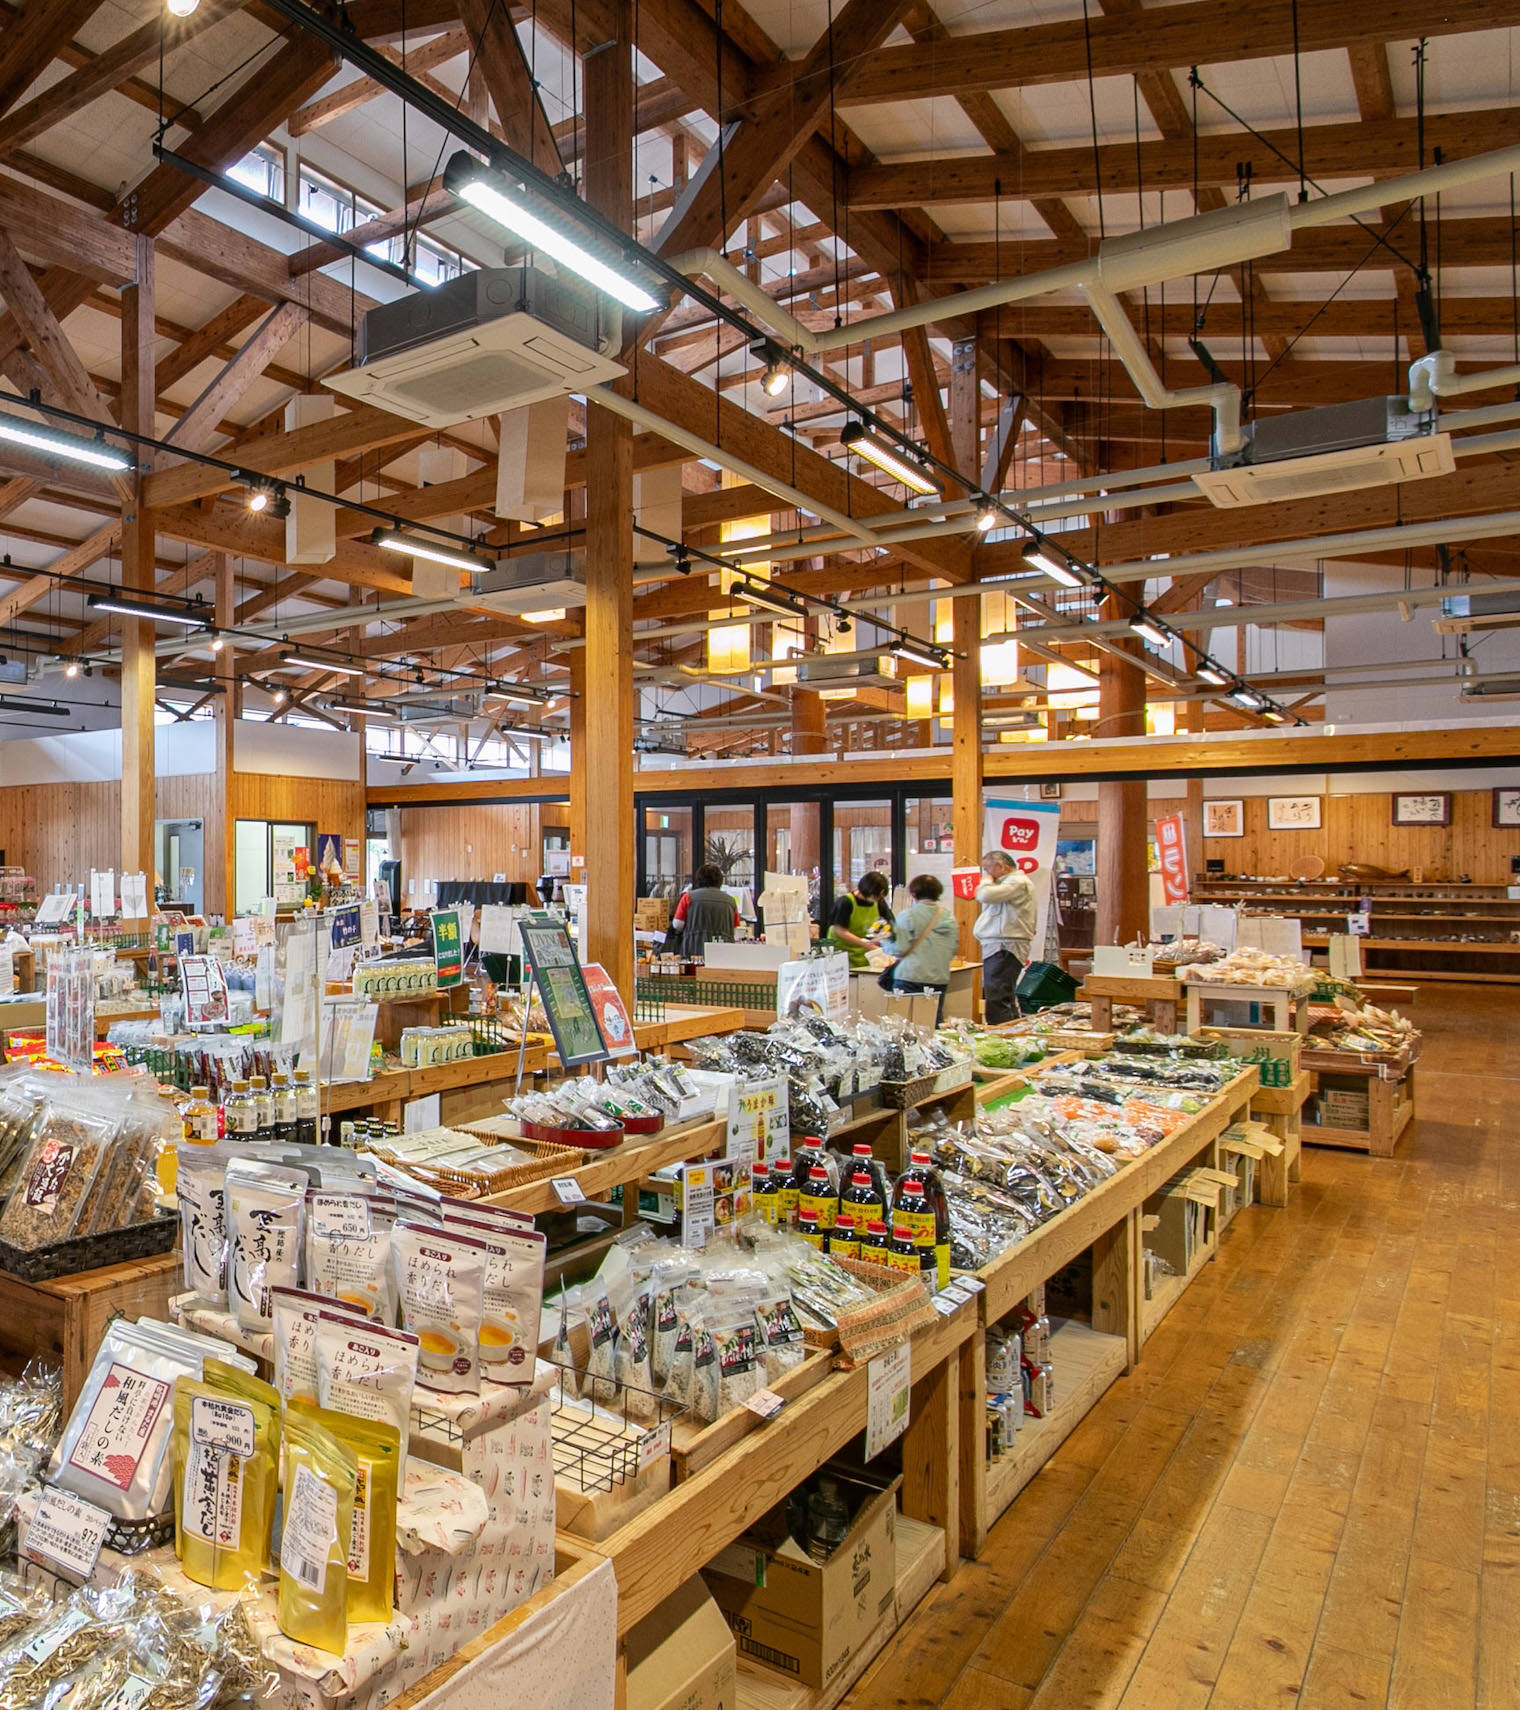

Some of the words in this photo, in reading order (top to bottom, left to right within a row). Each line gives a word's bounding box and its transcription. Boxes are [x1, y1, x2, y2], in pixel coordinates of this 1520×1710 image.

[1009, 825, 1034, 838] Pay
[438, 922, 458, 941] 半額
[342, 1223, 358, 1234] 650
[408, 1256, 457, 1279] ほめられ
[406, 1272, 456, 1296] 香りだし
[350, 1342, 377, 1356] あご入り
[335, 1350, 385, 1375] ほめられ
[331, 1366, 386, 1391] 香りだし
[201, 1401, 246, 1417] 本枯れ黄金だし
[90, 1376, 137, 1467] 和風だしの素
[225, 1434, 242, 1447] 900
[244, 1443, 251, 1451] 円
[43, 1493, 83, 1519] 和風だしの素
[81, 1527, 99, 1546] 972
